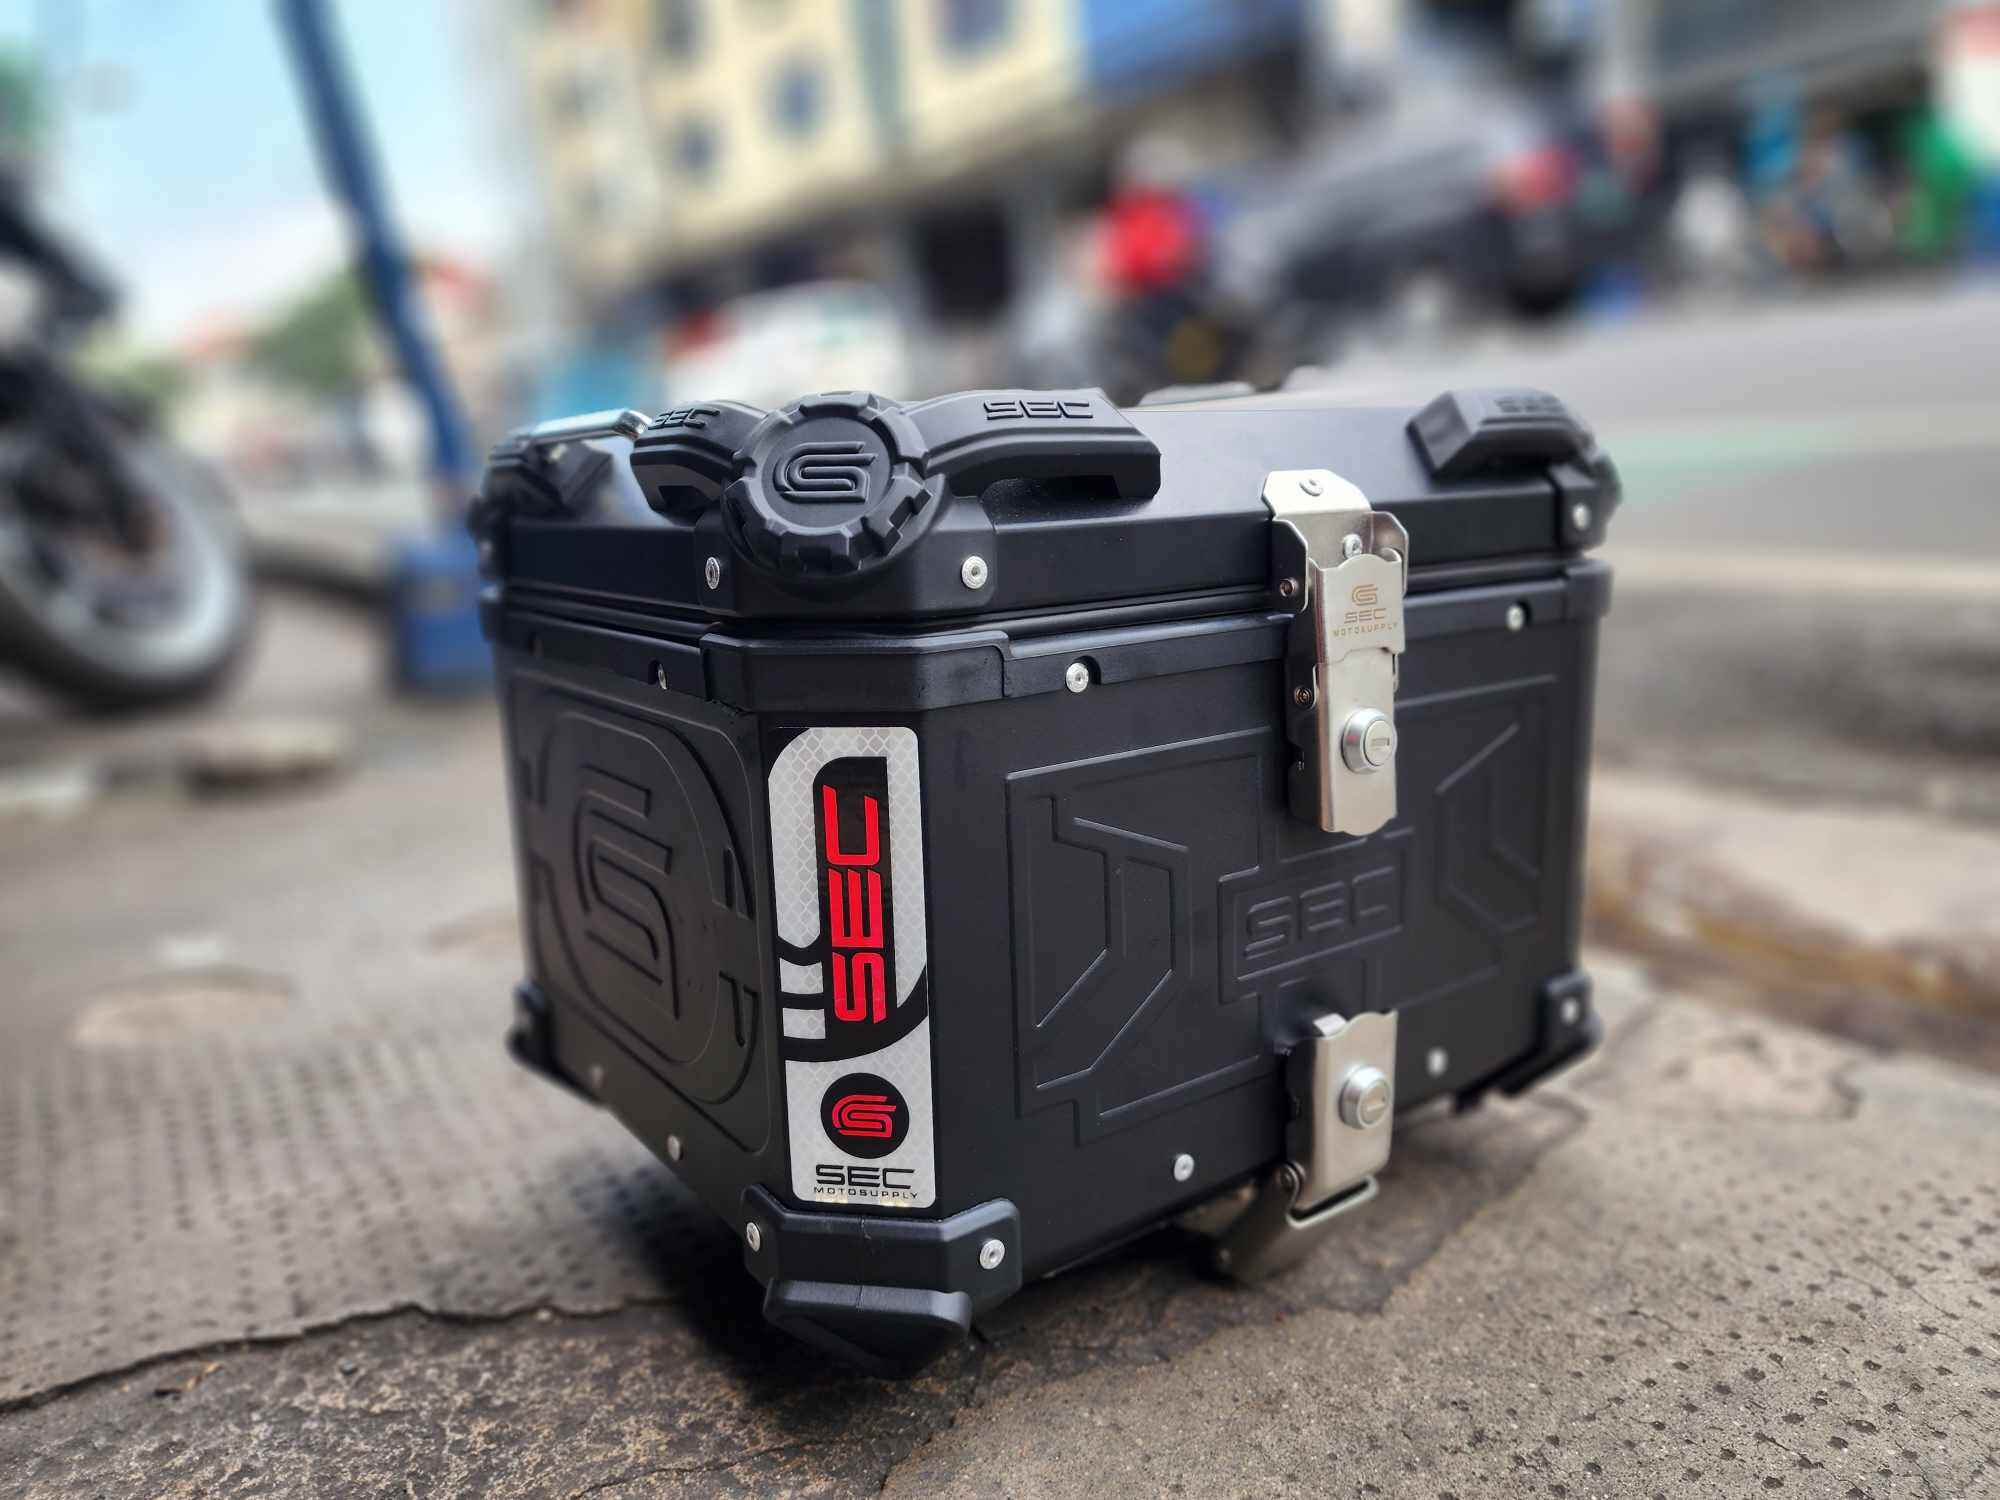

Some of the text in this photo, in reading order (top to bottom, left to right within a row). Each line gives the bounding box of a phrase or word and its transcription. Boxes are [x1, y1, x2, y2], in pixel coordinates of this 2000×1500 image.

[982, 399, 1094, 420] SEC
[1343, 607, 1387, 624] SEC
[822, 784, 887, 1025] SEC
[815, 1164, 916, 1190] SEC
[813, 1186, 918, 1200] MOTOSUPPLY
